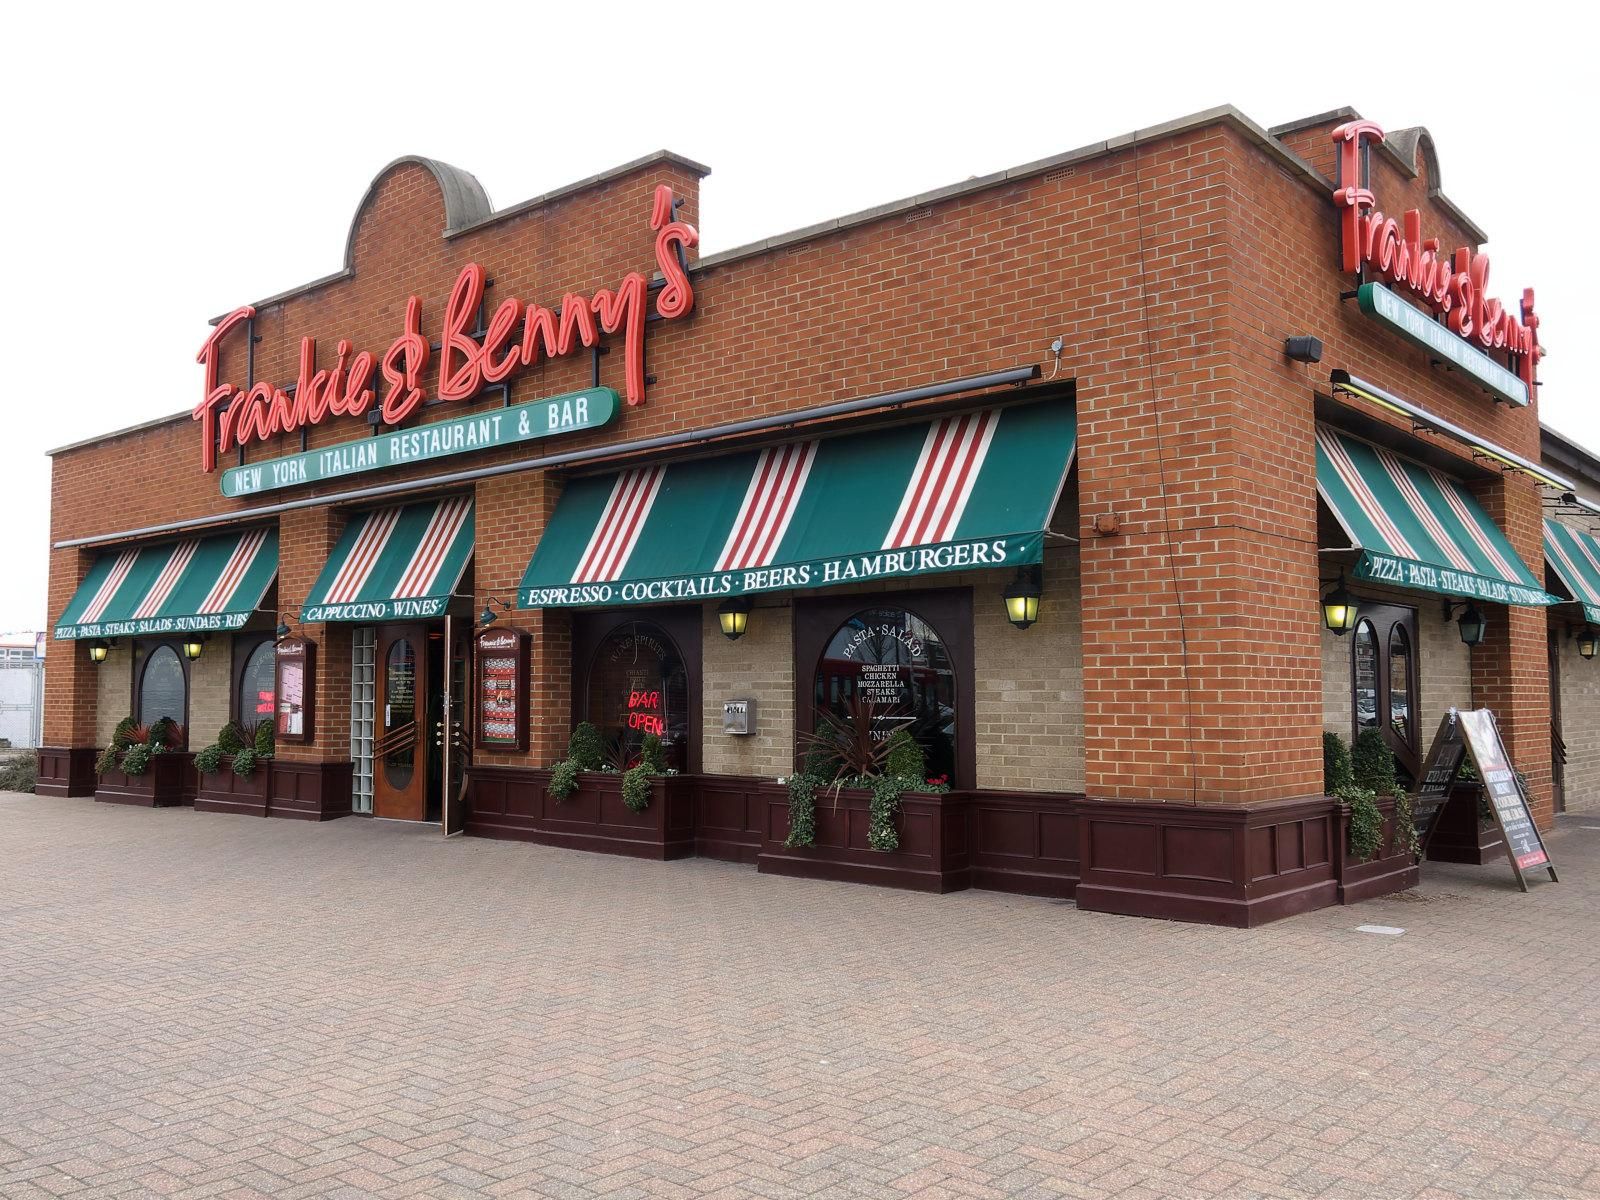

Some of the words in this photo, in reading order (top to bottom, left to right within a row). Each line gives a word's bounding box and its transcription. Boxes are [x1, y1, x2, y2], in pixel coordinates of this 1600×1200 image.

[192, 305, 377, 473] Frankie
[438, 184, 700, 406] Benny's
[235, 470, 261, 492] NEW
[272, 458, 307, 483] YORK
[320, 442, 377, 475] ITALIAN
[390, 416, 502, 459] RESTAURANT
[518, 409, 531, 435] &
[549, 397, 589, 429] BAR
[527, 584, 611, 606] ESPRESSO
[621, 574, 732, 601] COCKTAILS
[742, 564, 810, 591] BEERS
[822, 540, 1007, 583] HAMBURGERS
[1369, 556, 1404, 582] PIZZA
[1409, 564, 1438, 588] PASTA
[1441, 571, 1476, 595] STEAKS
[1477, 578, 1509, 600] SALADS
[307, 603, 385, 620] CAPPUCCINO
[393, 600, 439, 616] WINES
[56, 626, 77, 638] PIZZA
[80, 626, 101, 637] PASTA
[104, 622, 136, 635] STEAKS
[139, 619, 173, 632] SALADS
[175, 615, 221, 630] SUNDAES
[225, 613, 249, 627] RIBS
[843, 626, 876, 659] PASTA
[881, 624, 921, 657] SALAD
[861, 664, 900, 672] SPAGHETTI
[628, 691, 658, 709] BAR
[629, 712, 663, 736] OPEN
